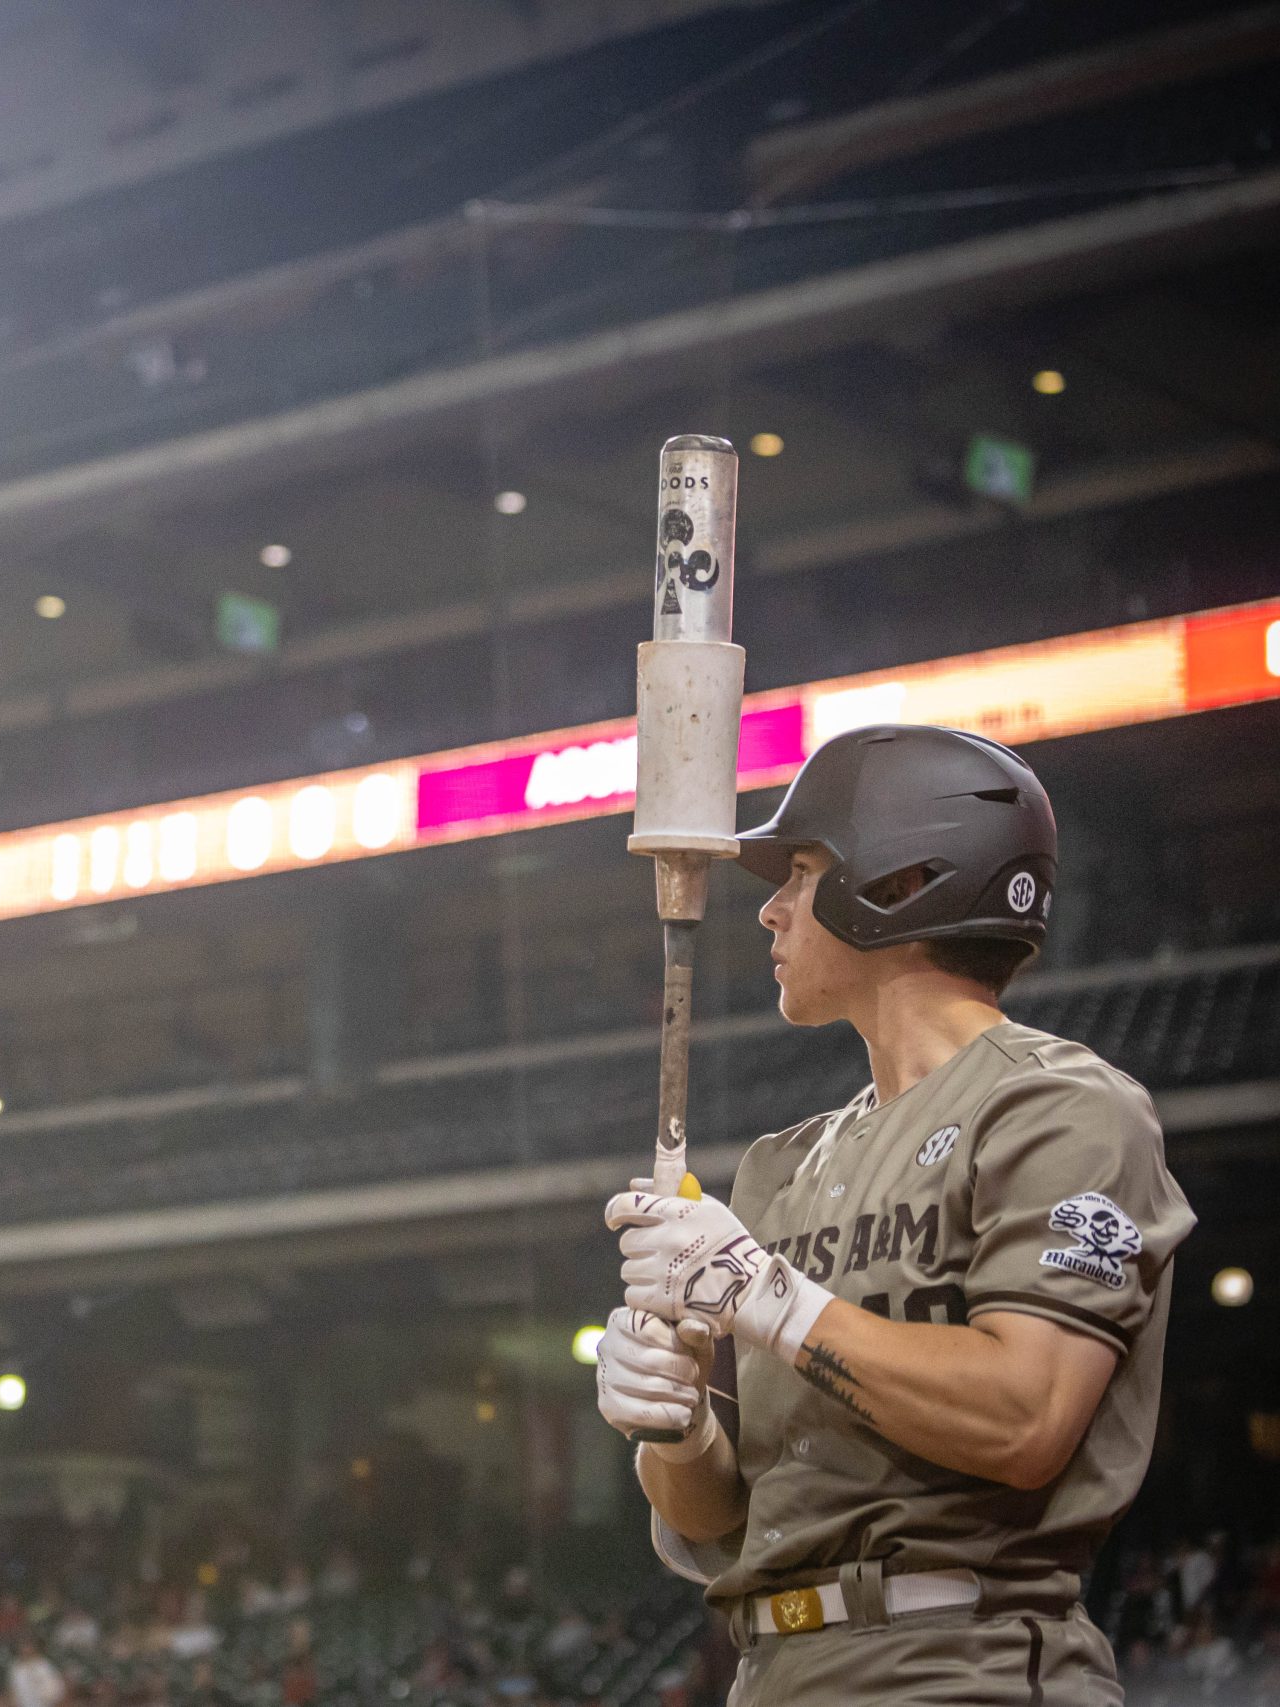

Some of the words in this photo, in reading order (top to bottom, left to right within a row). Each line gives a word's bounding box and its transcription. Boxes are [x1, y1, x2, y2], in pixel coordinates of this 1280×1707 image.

[1011, 876, 1033, 908] SEC
[918, 1126, 960, 1166] SEC
[842, 1203, 940, 1276] A&M
[1051, 1203, 1087, 1229] S
[1122, 1225, 1139, 1250] 2
[1045, 1251, 1123, 1287] Marauders
